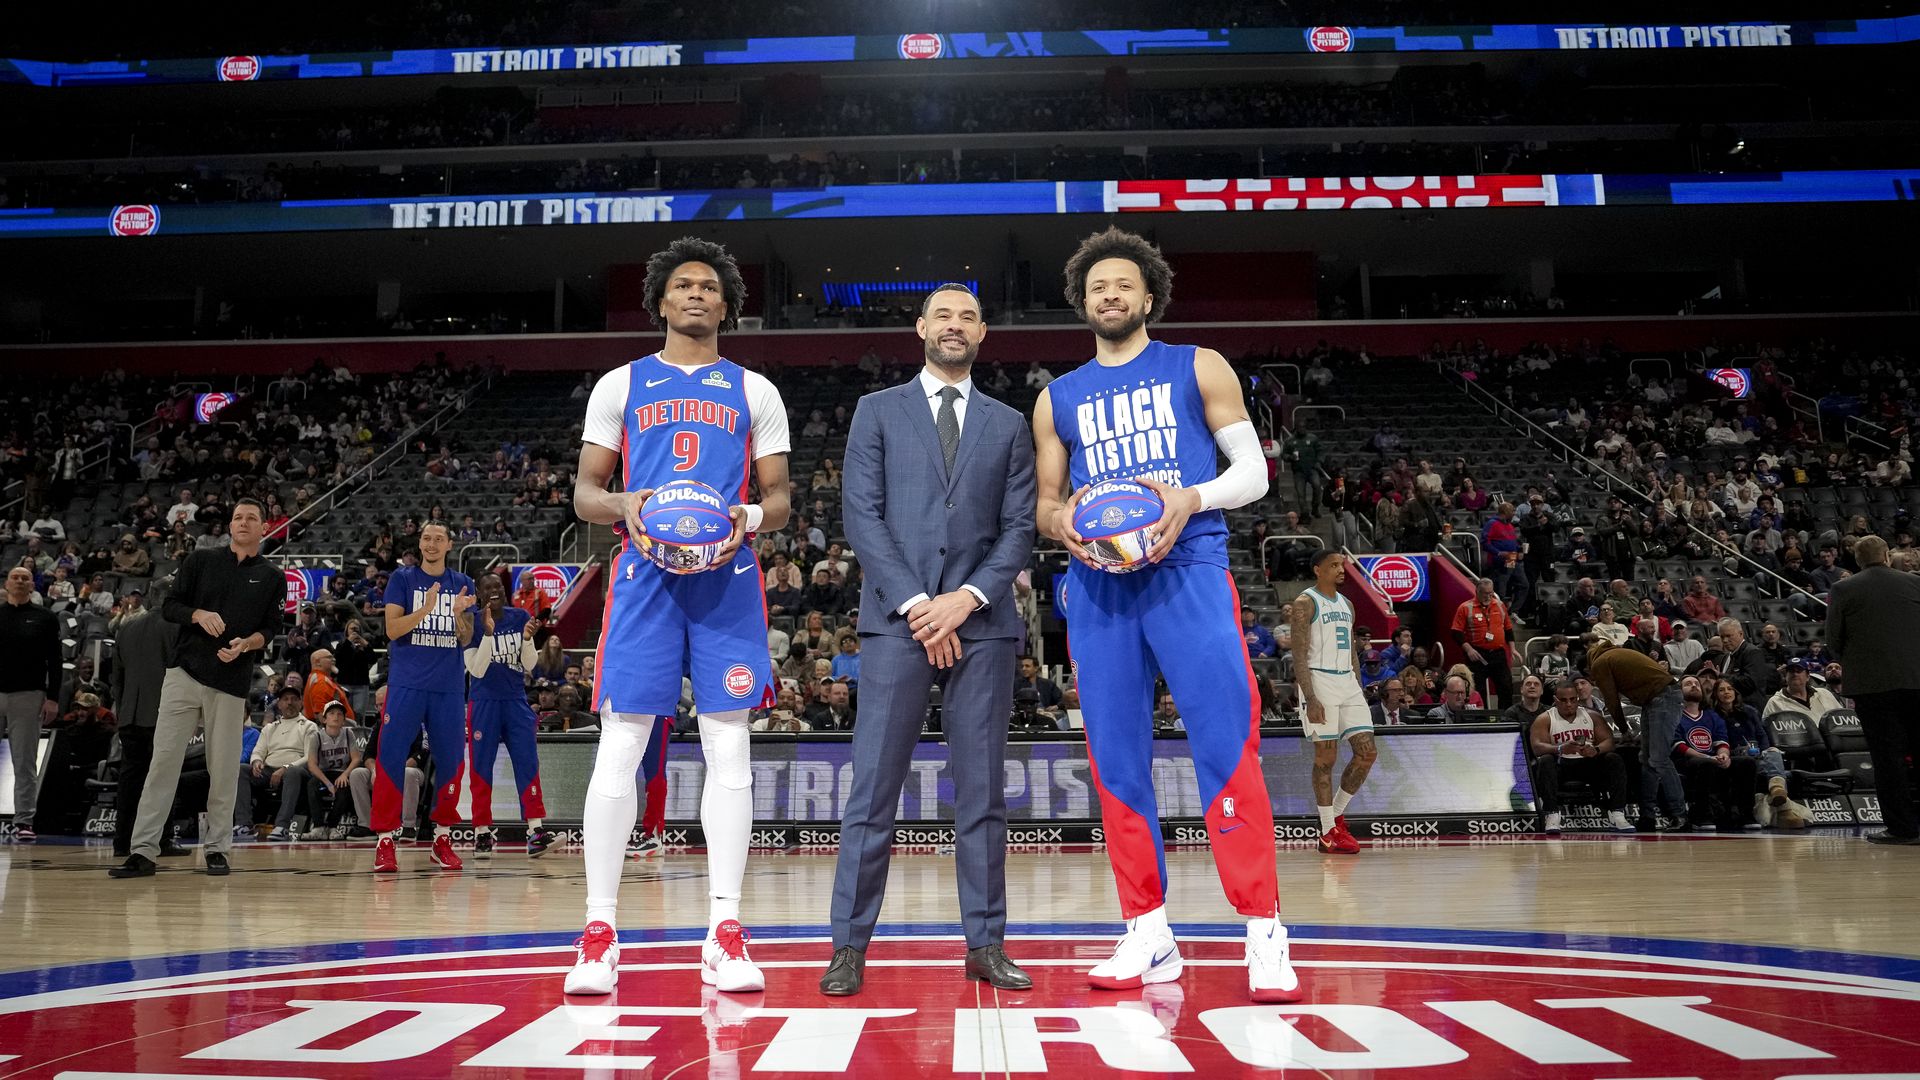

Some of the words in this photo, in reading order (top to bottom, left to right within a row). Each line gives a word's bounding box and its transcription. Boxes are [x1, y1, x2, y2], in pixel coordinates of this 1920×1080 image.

[1554, 27, 1671, 50] DETROIT
[1680, 25, 1792, 48] PISTONS
[451, 48, 565, 73] DETROIT
[574, 44, 683, 69] PISTONS
[389, 200, 528, 229] DETROIT
[540, 196, 674, 224] PISTONS
[1086, 384, 1128, 401] BUILT
[1139, 378, 1156, 386] BY
[634, 398, 740, 435] DETROIT
[1077, 382, 1178, 448] BLACK
[672, 430, 700, 472] 9
[1085, 427, 1178, 478] HISTORY
[656, 487, 721, 509] Wilson
[1081, 482, 1144, 507] Wilson
[534, 578, 561, 588] ETROIT
[1377, 569, 1412, 579] DETROIT
[1335, 626, 1350, 650] 3
[1772, 718, 1807, 732] UWM
[1563, 804, 1602, 818] Little
[799, 830, 840, 844] Stoc
[1006, 828, 1062, 843] tockX
[1370, 820, 1439, 836] StockX
[1467, 817, 1536, 833] StockX
[180, 992, 1838, 1074] DETROIT
